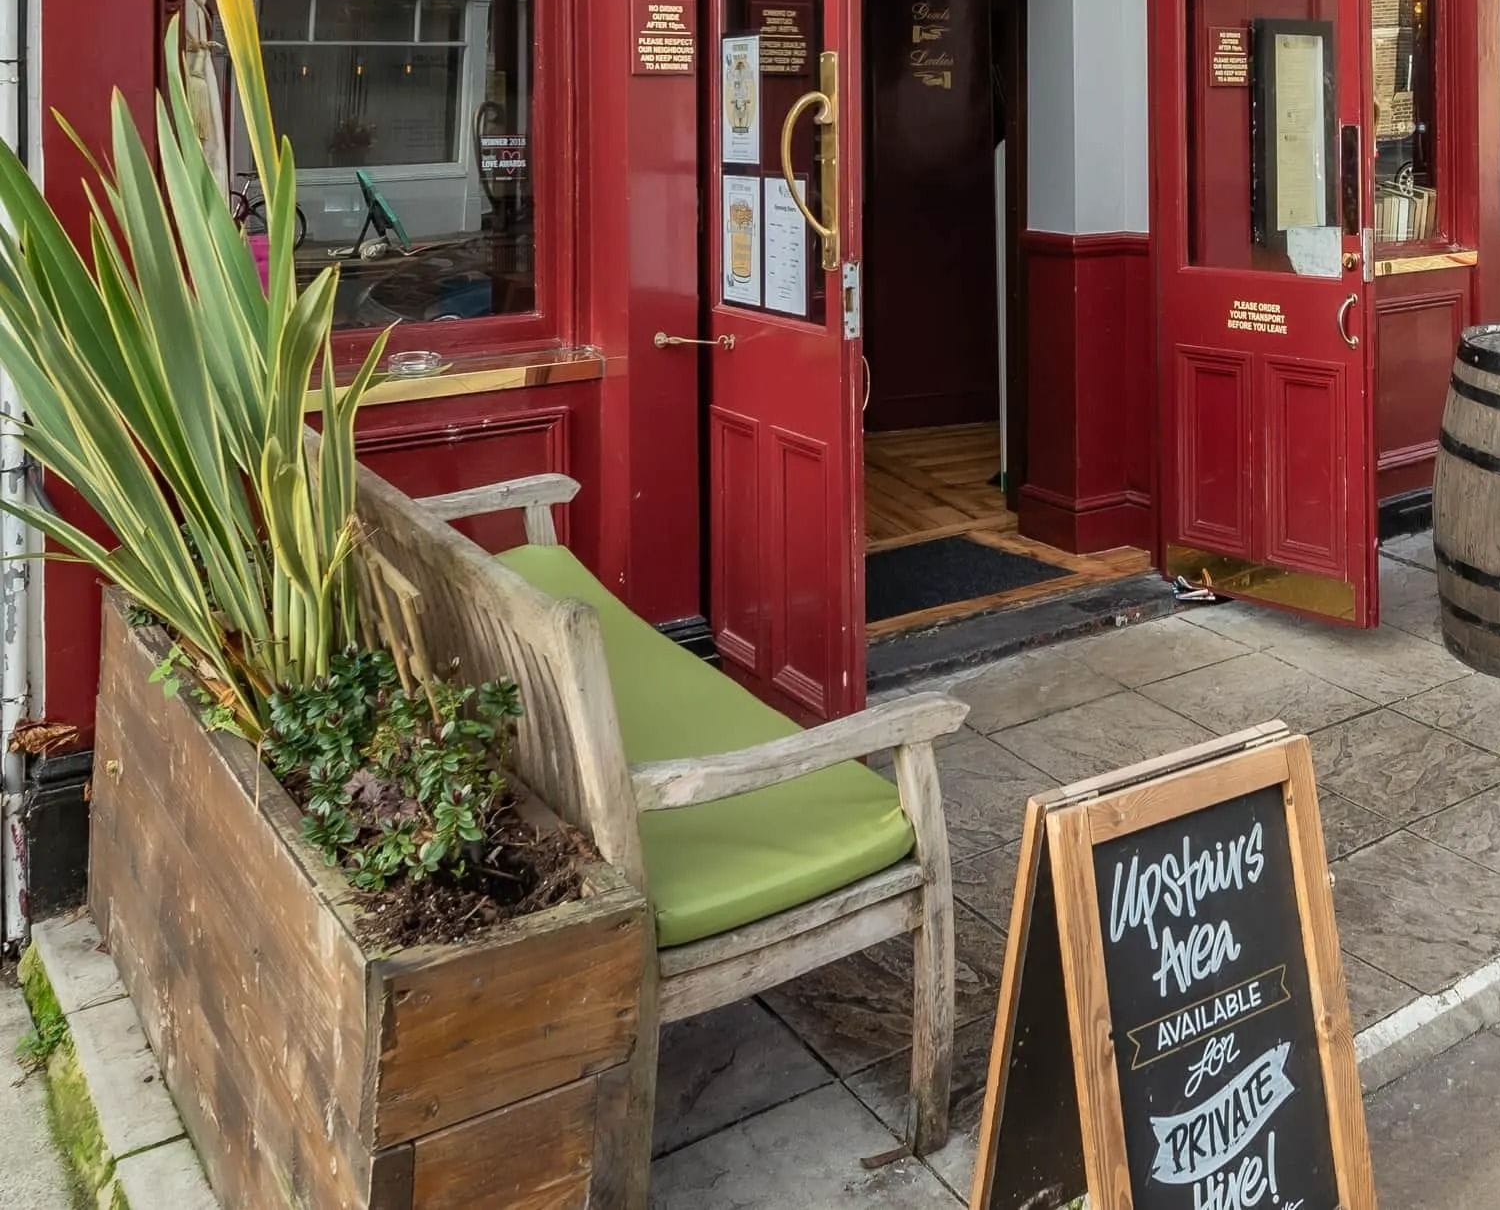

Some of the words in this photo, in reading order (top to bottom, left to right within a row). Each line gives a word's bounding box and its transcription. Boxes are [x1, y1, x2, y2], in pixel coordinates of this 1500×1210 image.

[648, 4, 659, 12] NO
[659, 5, 684, 13] DRINKS
[652, 13, 680, 21] OUTSIDE
[646, 21, 668, 29] AFTER
[638, 37, 664, 45] PLEASE
[664, 38, 693, 46] RESPECT
[653, 46, 694, 54] NEIGHBOURS
[640, 54, 654, 62] AND
[655, 54, 672, 62] KEEP
[645, 62, 654, 70] TO
[1233, 300, 1258, 311] PLEASE
[1258, 302, 1281, 313] ORDER
[1229, 309, 1247, 320] YOUR
[1247, 311, 1286, 324] TRANSPORT
[1227, 319, 1253, 331] BEFORE
[1252, 322, 1266, 332] YOU
[1267, 324, 1288, 335] LEAVE
[1110, 822, 1265, 950] Upstairs
[1152, 920, 1242, 998] Area
[1157, 980, 1263, 1051] AVAILABLE
[1184, 1032, 1241, 1098] for
[1164, 1060, 1275, 1175] PRIVATE
[1193, 1131, 1280, 1210] Hire!
